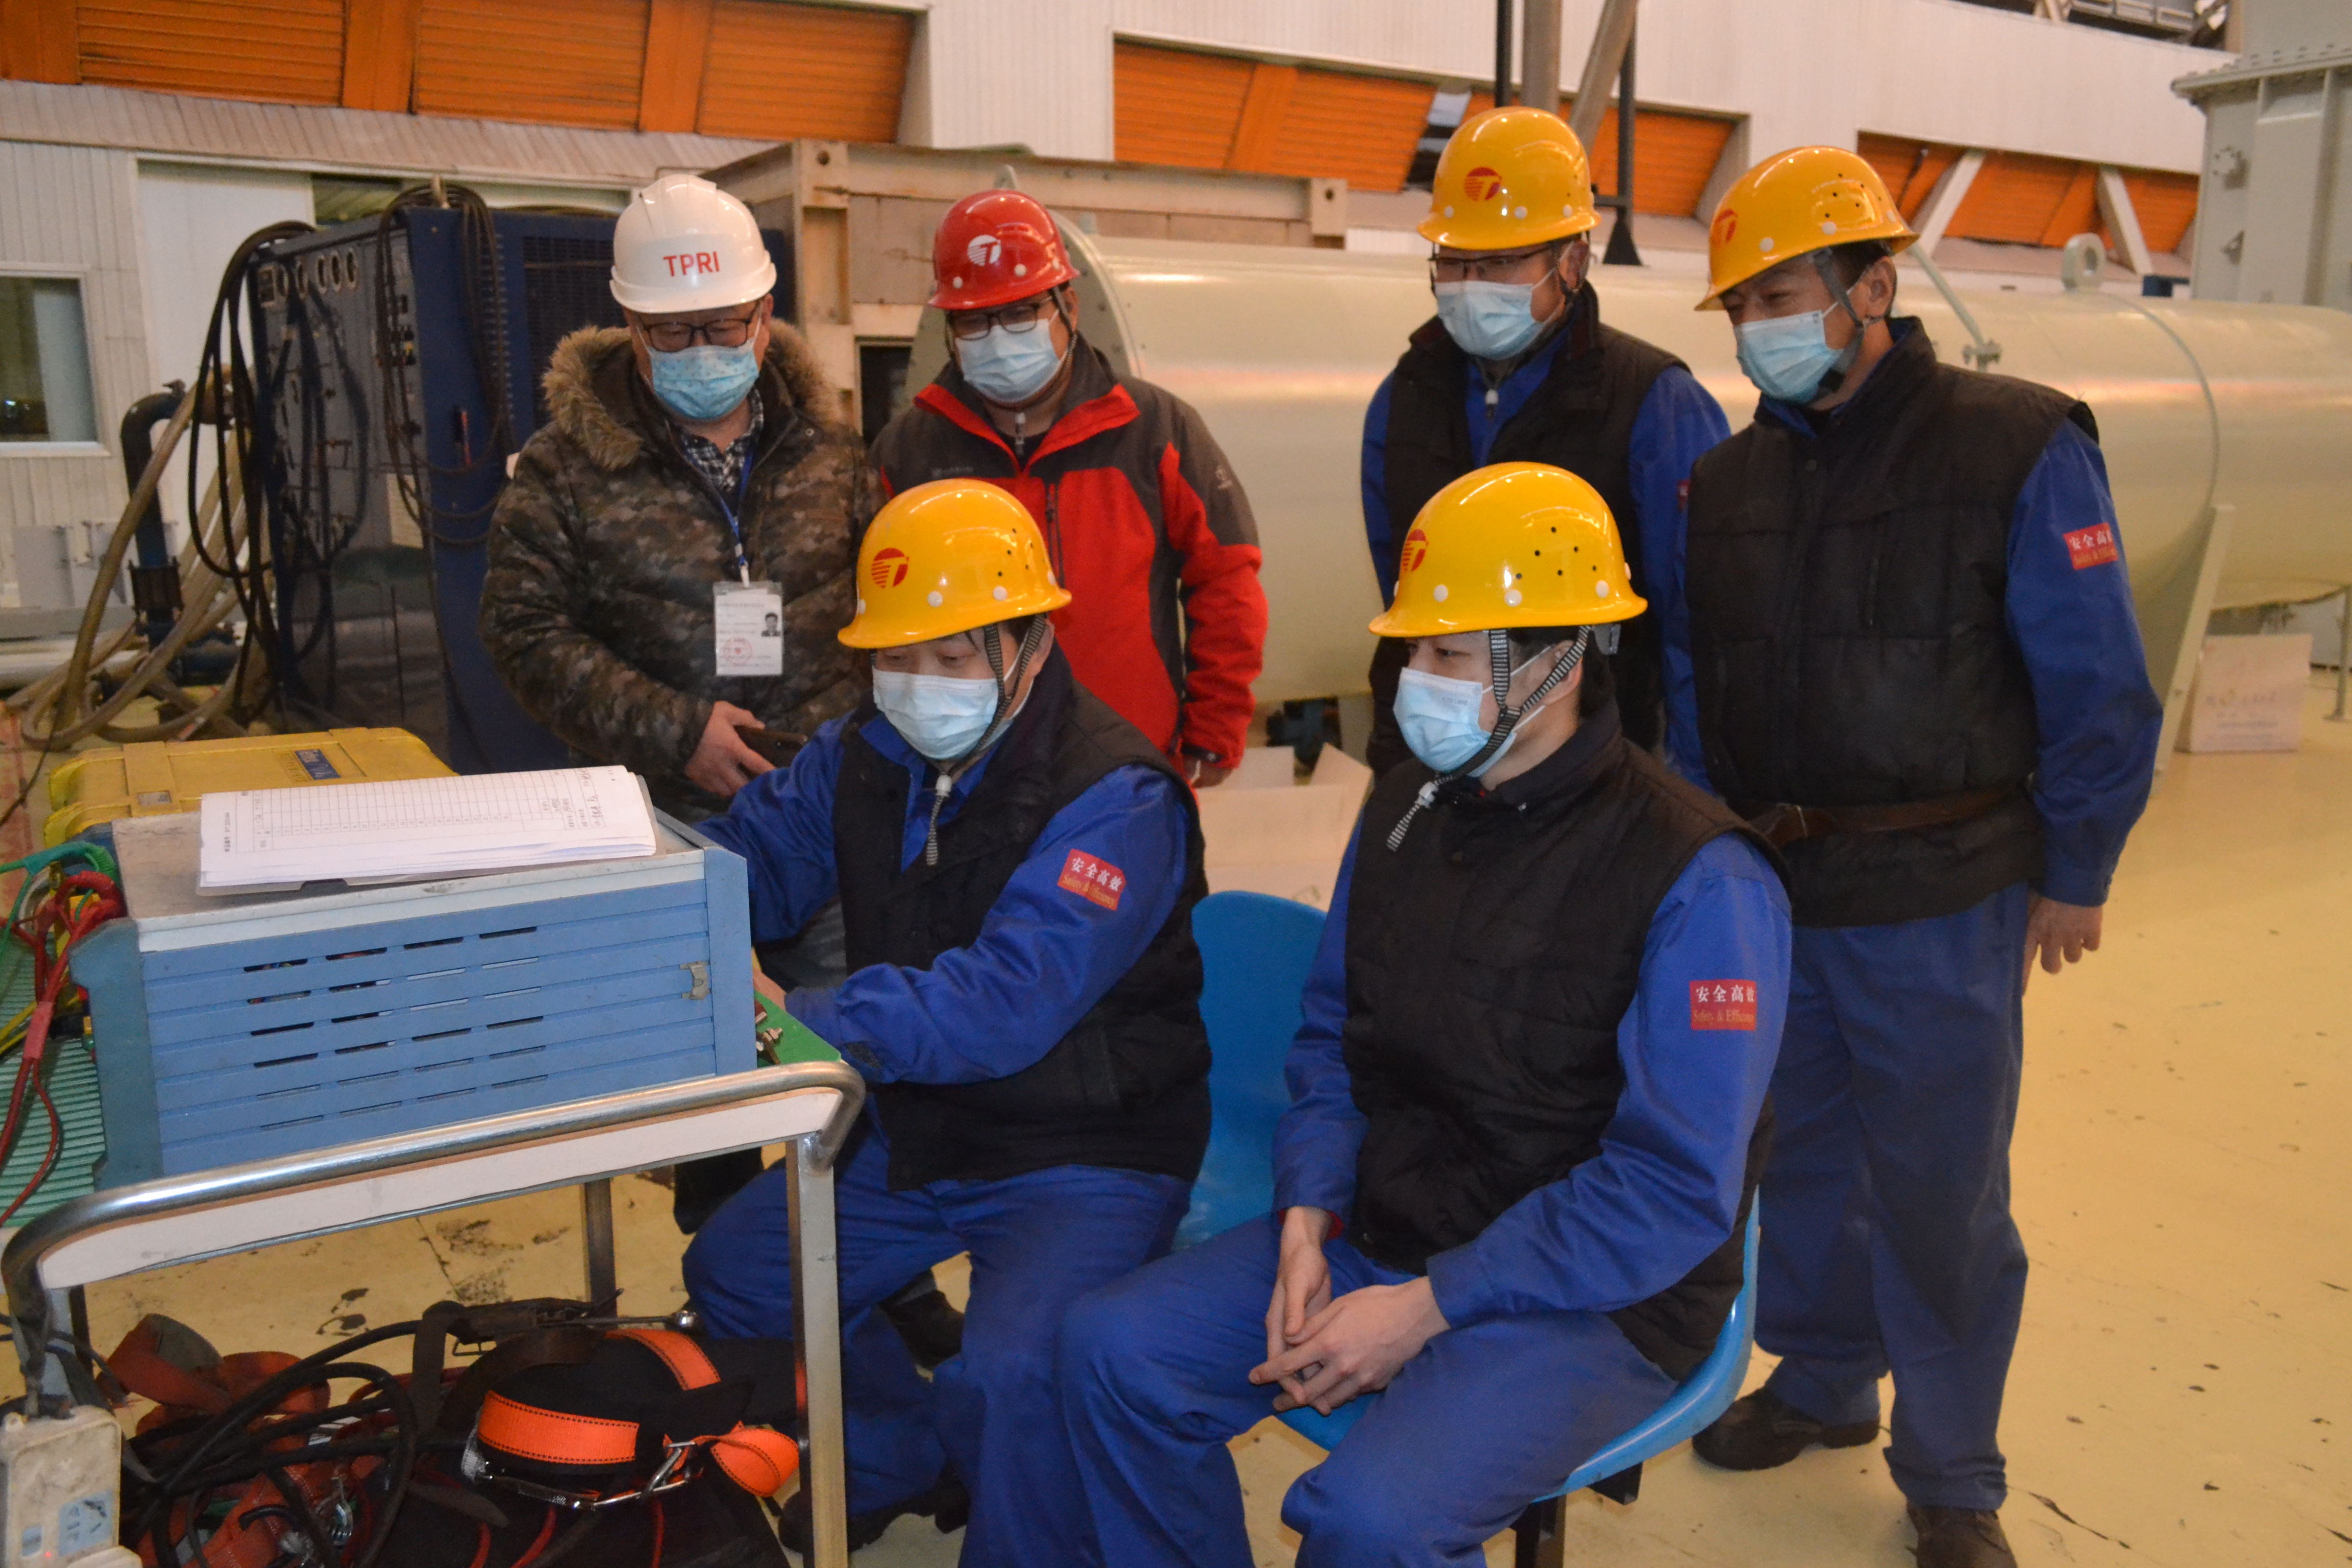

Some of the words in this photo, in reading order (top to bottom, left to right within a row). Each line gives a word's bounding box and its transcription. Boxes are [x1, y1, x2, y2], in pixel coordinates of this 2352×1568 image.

[663, 251, 720, 277] TPRI
[1071, 857, 1122, 891] 安全高效
[1696, 984, 1755, 1003] 安全高效
